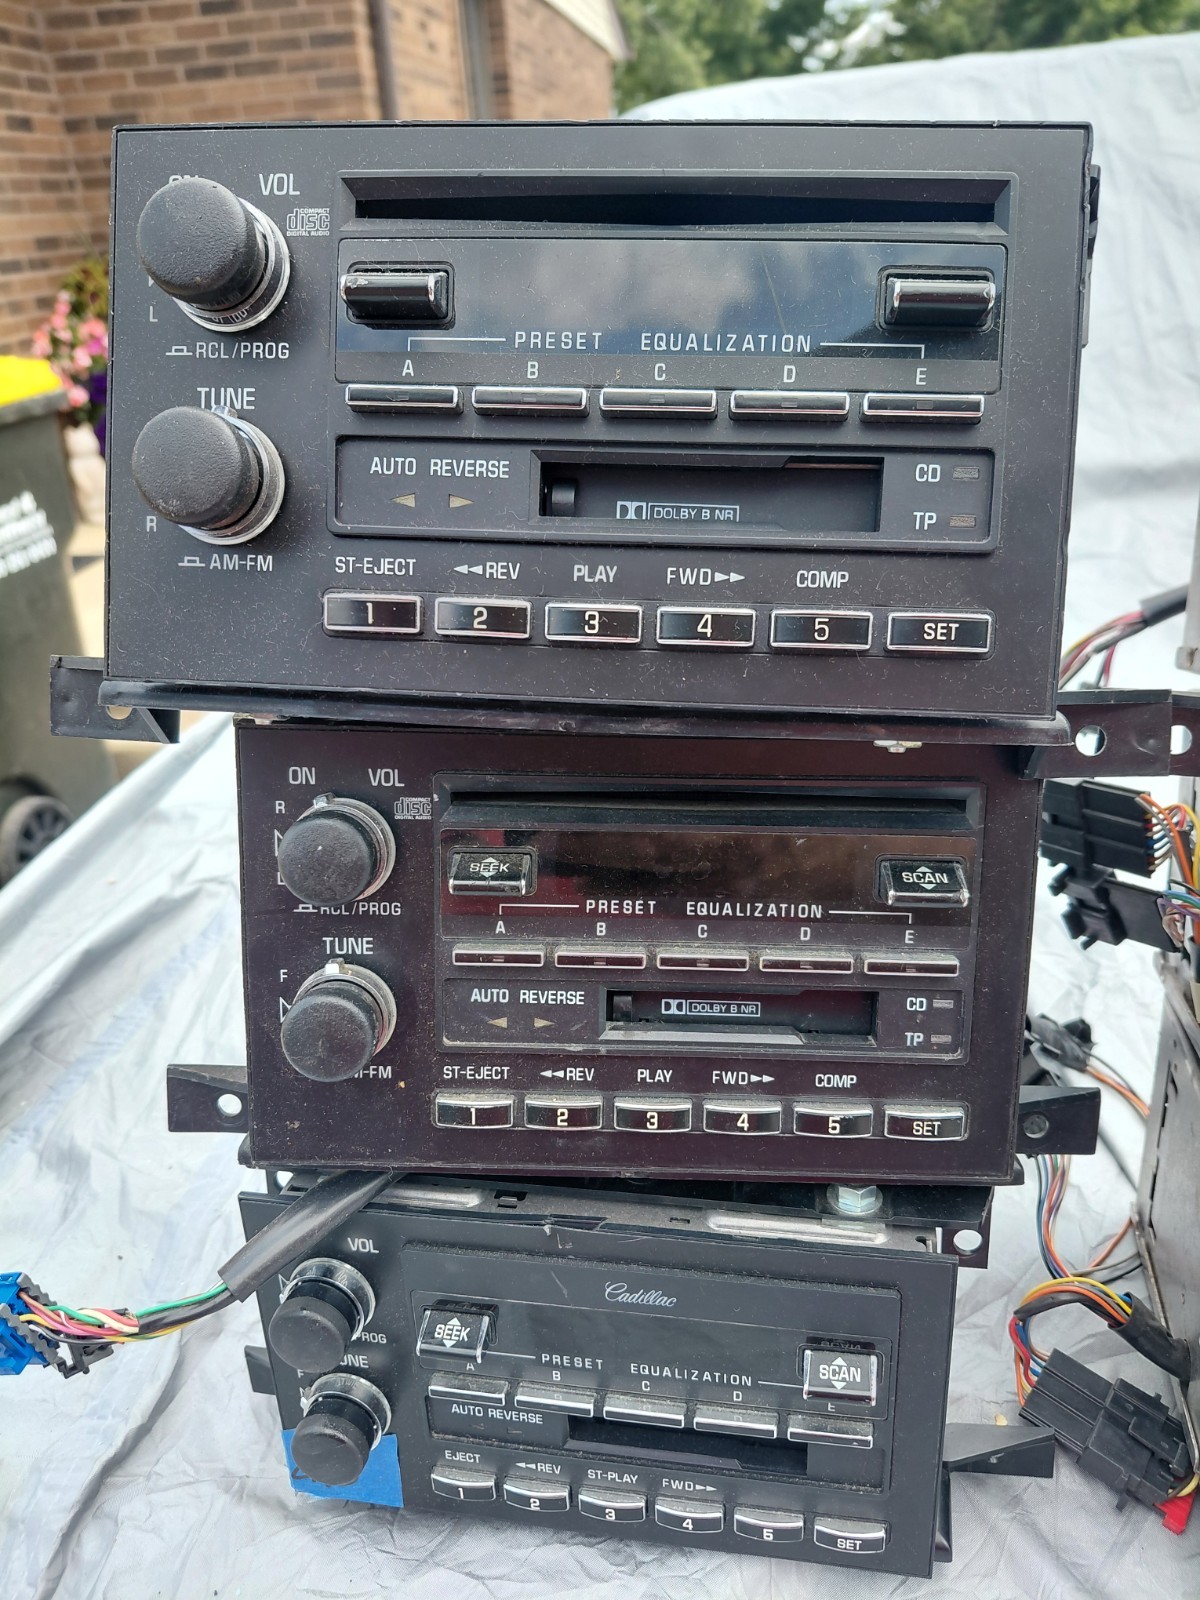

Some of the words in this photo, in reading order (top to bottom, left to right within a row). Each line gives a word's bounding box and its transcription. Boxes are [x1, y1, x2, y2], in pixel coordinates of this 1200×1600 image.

[259, 174, 300, 195] VOL
[150, 306, 158, 322] L
[196, 342, 290, 360] RCL/PROG
[514, 332, 602, 350] PRESET
[641, 333, 812, 352] EQUALIZATION
[402, 359, 414, 377] A
[527, 361, 538, 379] B
[654, 363, 666, 381] C
[784, 365, 796, 383] D
[916, 368, 927, 386] E
[197, 388, 256, 410] TUNE
[370, 457, 417, 476] AUTO
[430, 459, 510, 479] REVERSE
[915, 464, 941, 482] CD
[654, 508, 698, 520] DOLBY
[702, 509, 710, 520] B
[715, 510, 734, 520] NR
[913, 512, 938, 531] TP
[146, 516, 157, 532] R
[210, 554, 273, 572] AM-FM
[335, 556, 416, 576] ST-EJECT
[485, 562, 520, 580] REV
[573, 564, 618, 583] PLAY
[667, 568, 712, 586] FWD
[796, 570, 849, 588] COMP
[366, 602, 375, 624] 1
[473, 606, 488, 629] 2
[584, 611, 600, 634] 3
[696, 614, 713, 638] 4
[814, 618, 830, 640] 5
[923, 622, 960, 642] SET
[288, 766, 316, 785] ON
[368, 768, 405, 787] VOL
[275, 800, 286, 814] R
[470, 862, 510, 873] SEEK
[902, 871, 949, 884] SCAN
[586, 900, 656, 914] PRESET
[686, 901, 822, 919] EQUALIZATION
[495, 920, 506, 934] A
[596, 922, 606, 936] B
[697, 924, 708, 938] C
[800, 927, 810, 941] D
[322, 937, 374, 955] TUNE
[904, 930, 915, 944] E
[280, 970, 288, 982] F
[470, 988, 510, 1003] AUTO
[520, 990, 585, 1005] REVERSE
[906, 998, 926, 1012] CD
[692, 1003, 727, 1013] DOLBY
[730, 1004, 738, 1013] B
[741, 1005, 756, 1014] NR
[904, 1032, 924, 1046] TP
[443, 1066, 510, 1080] ST-EJECT
[566, 1068, 594, 1081] REV
[637, 1069, 672, 1083] PLAY
[712, 1070, 748, 1085] FWD
[815, 1074, 857, 1088] COMP
[470, 1108, 476, 1126] 1
[557, 1108, 569, 1126] 2
[646, 1112, 658, 1130] 3
[736, 1113, 750, 1131] 4
[828, 1116, 840, 1134] 5
[912, 1121, 942, 1136] SET
[348, 1237, 380, 1254] VOL
[604, 1281, 677, 1307] Cadillac
[434, 1324, 471, 1342] SEEK
[466, 1362, 476, 1371] A
[541, 1353, 604, 1370] PRESET
[630, 1362, 752, 1387] EQUALIZATION
[552, 1370, 561, 1381] B
[819, 1364, 862, 1383] SCAN
[642, 1380, 650, 1392] C
[733, 1390, 742, 1402] D
[452, 1403, 484, 1417] AUTO
[488, 1408, 544, 1424] REVERSE
[444, 1450, 481, 1464] EJECT
[537, 1462, 562, 1475] REV
[587, 1468, 638, 1484] ST-PLAY
[457, 1488, 464, 1500] 1
[662, 1478, 694, 1492] FWD
[530, 1498, 540, 1510] 2
[604, 1508, 616, 1521] 3
[682, 1518, 694, 1531] 4
[762, 1528, 774, 1542] 5
[836, 1538, 862, 1551] SET
